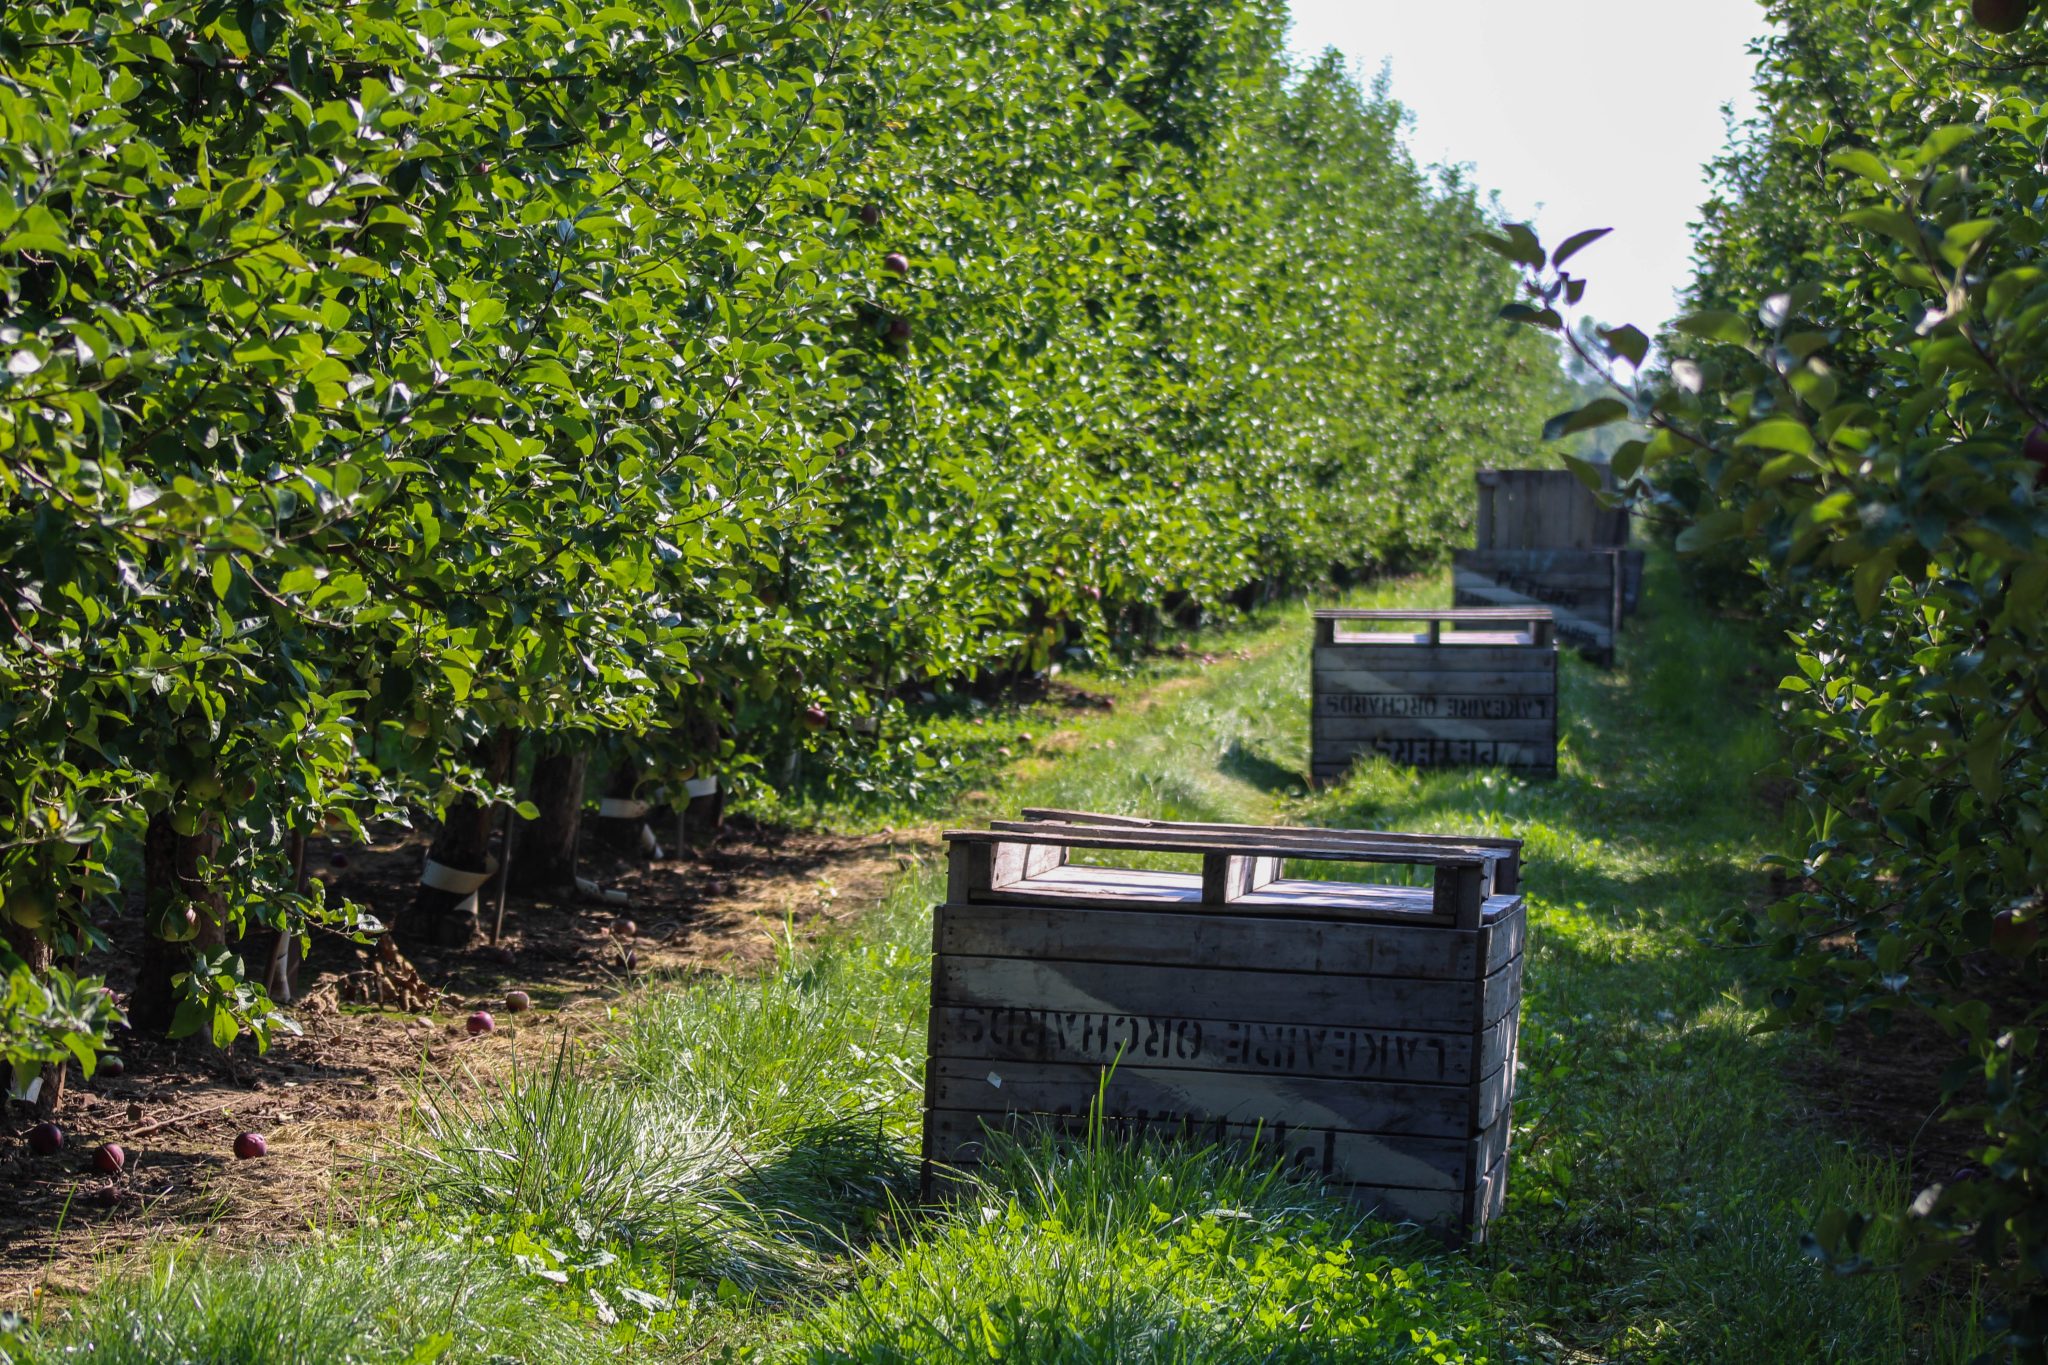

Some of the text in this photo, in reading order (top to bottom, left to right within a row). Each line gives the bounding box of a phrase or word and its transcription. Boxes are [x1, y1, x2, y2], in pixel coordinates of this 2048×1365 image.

[1327, 694, 1546, 719] LAKEAIRE ORCHARDS
[960, 1006, 1446, 1079] LAKEAIRE ORCHARDS
